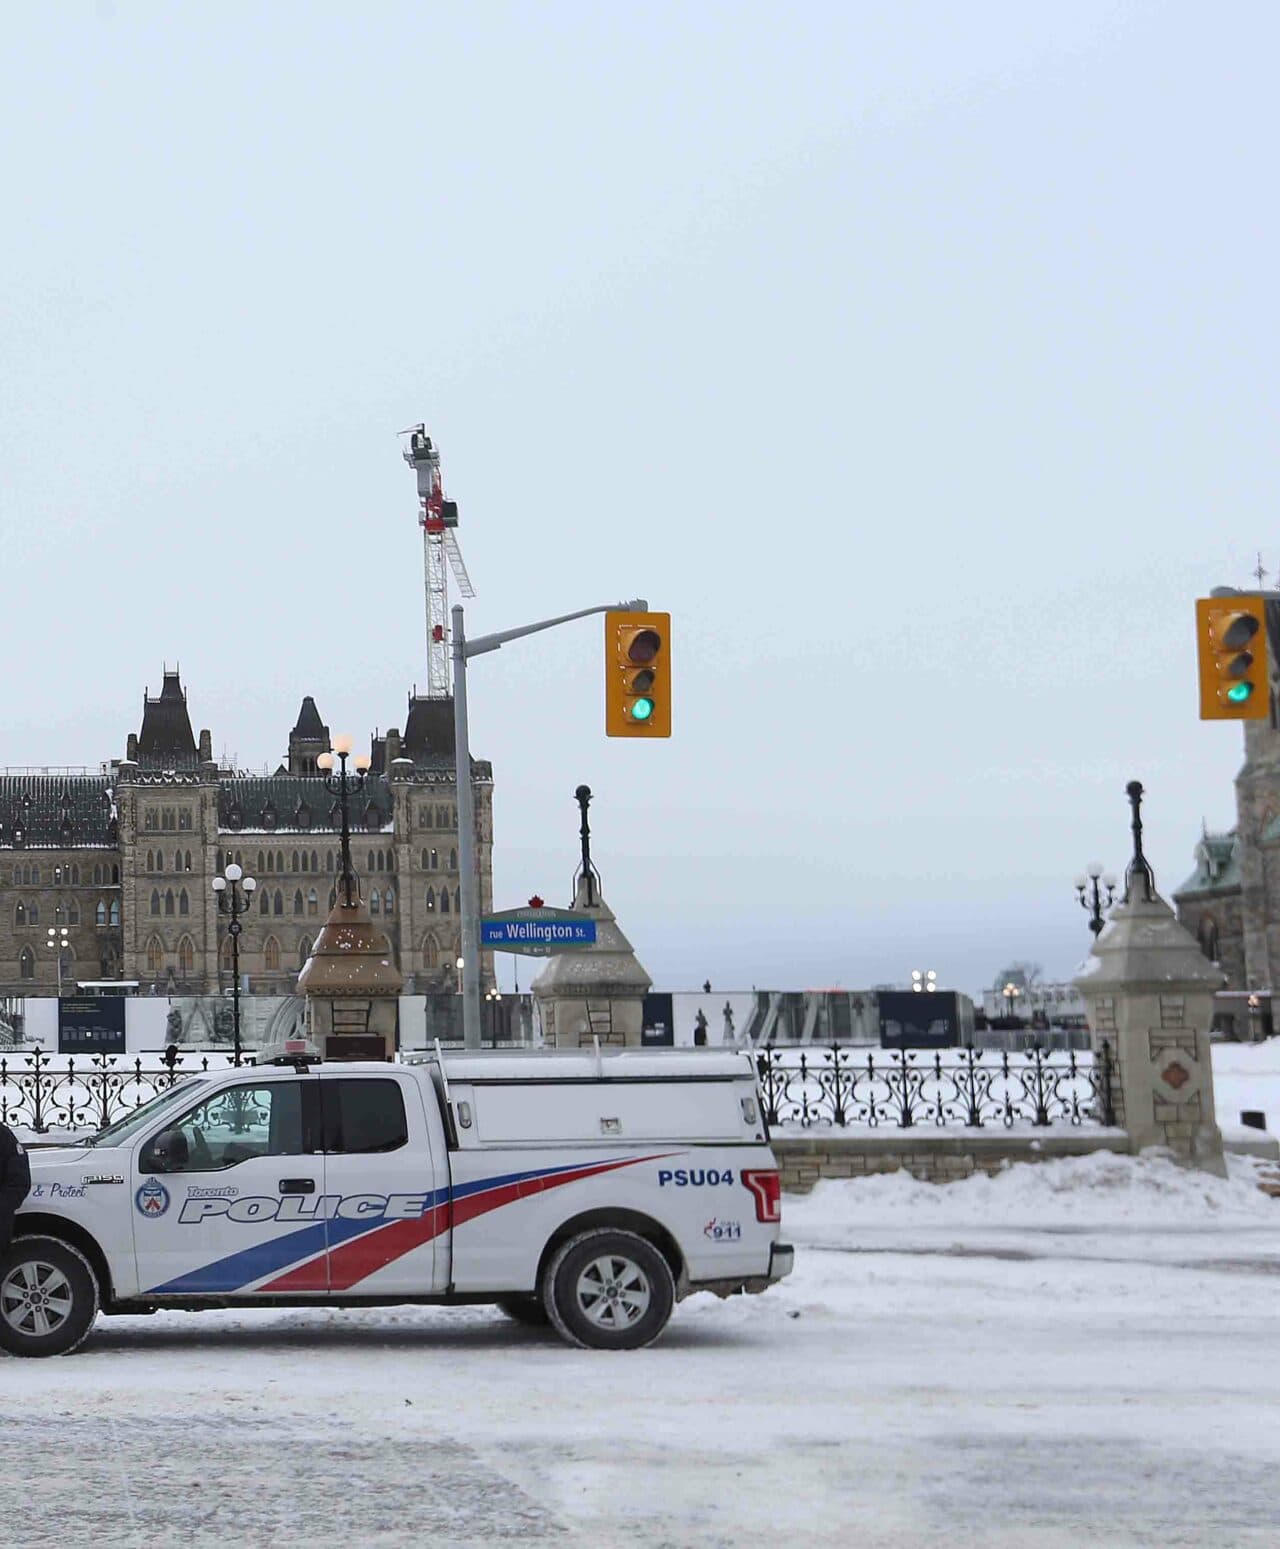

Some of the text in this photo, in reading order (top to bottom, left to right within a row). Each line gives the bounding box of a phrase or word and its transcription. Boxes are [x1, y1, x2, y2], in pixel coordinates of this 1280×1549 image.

[489, 923, 586, 941] rue Wellington St.
[658, 1169, 734, 1187] PSU04
[32, 1182, 89, 1198] & Protect
[187, 1185, 239, 1198] Toronto
[178, 1194, 428, 1224] POLICE
[713, 1226, 741, 1239] 911
